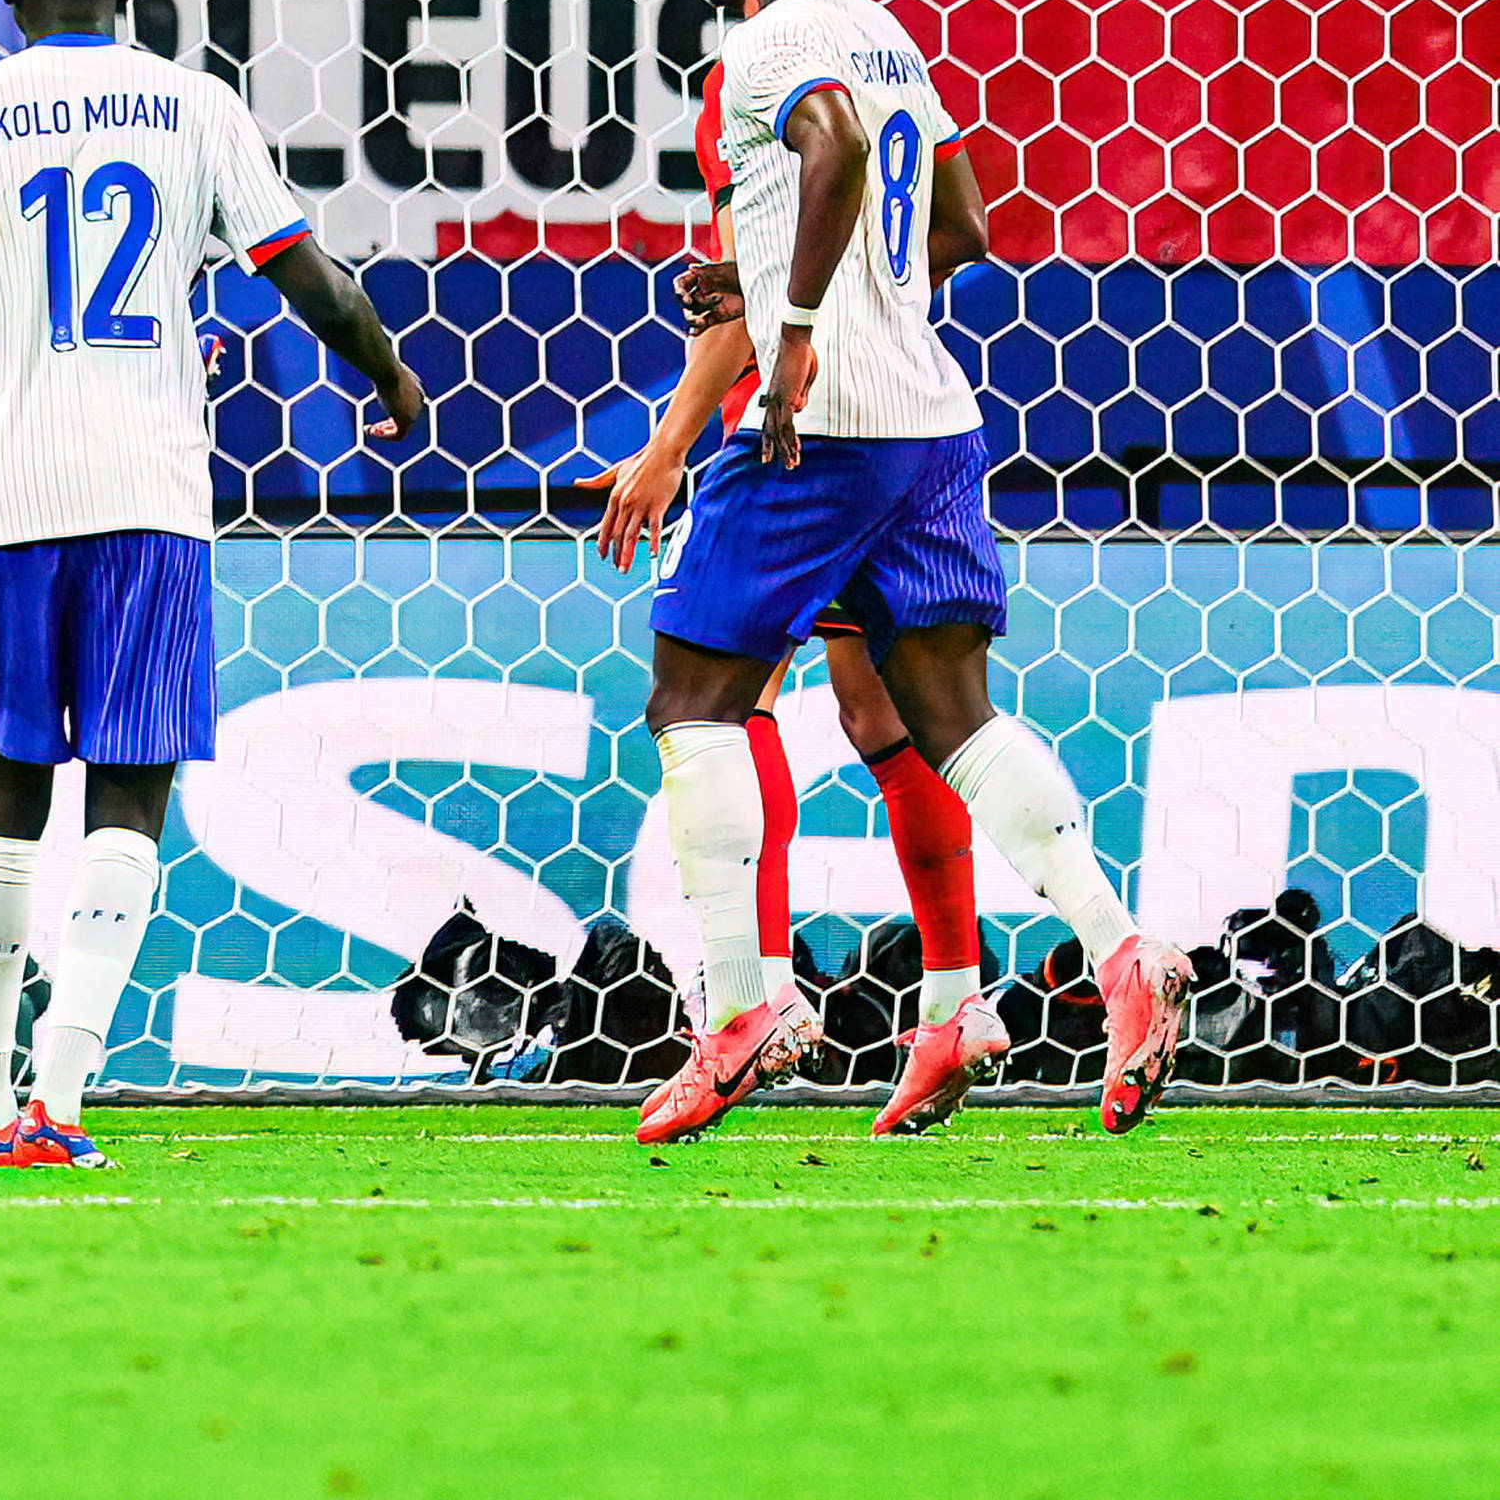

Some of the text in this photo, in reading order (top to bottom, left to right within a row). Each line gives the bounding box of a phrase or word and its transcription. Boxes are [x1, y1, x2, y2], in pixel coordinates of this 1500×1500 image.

[83, 93, 179, 134] MUANI
[19, 161, 163, 352] 12
[879, 108, 923, 287] 8
[659, 507, 694, 580] 8
